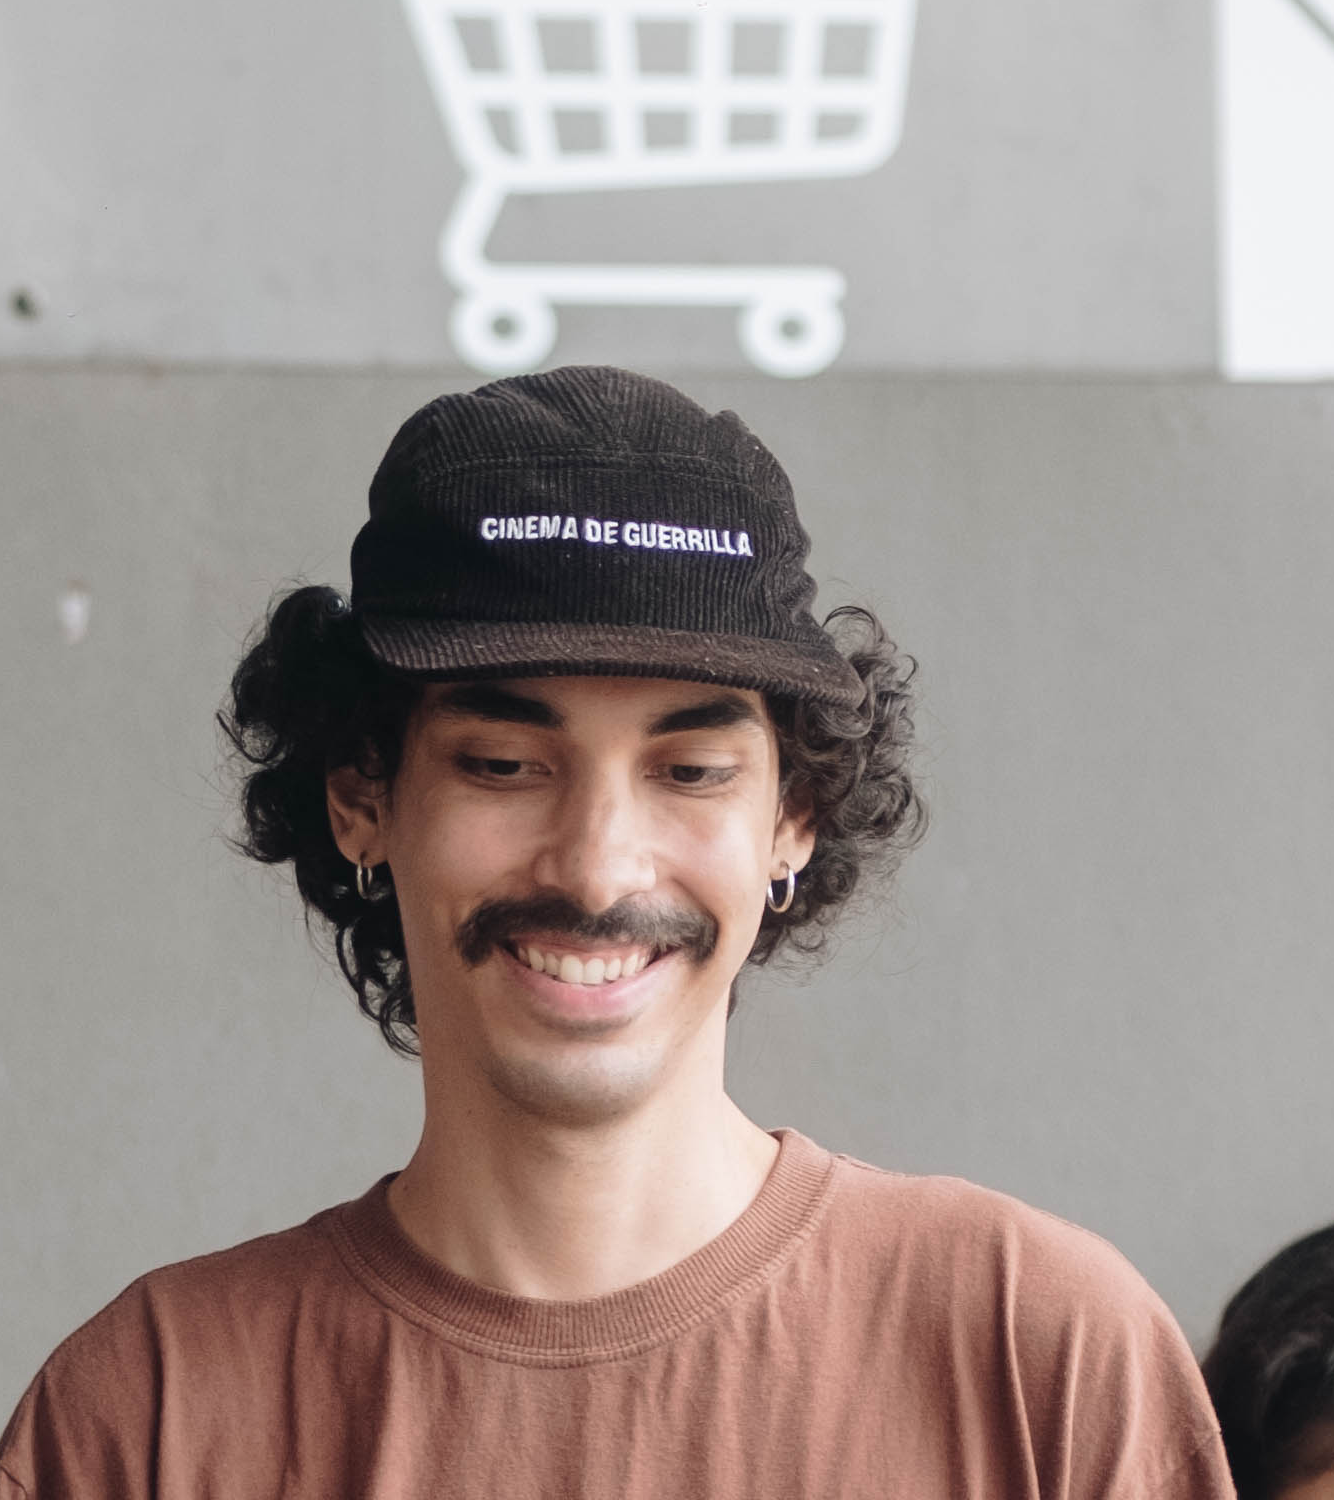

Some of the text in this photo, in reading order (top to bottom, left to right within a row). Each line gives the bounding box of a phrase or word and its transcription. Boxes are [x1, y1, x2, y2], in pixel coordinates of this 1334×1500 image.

[480, 515, 754, 557] CINEMA DE GUERRILLA
